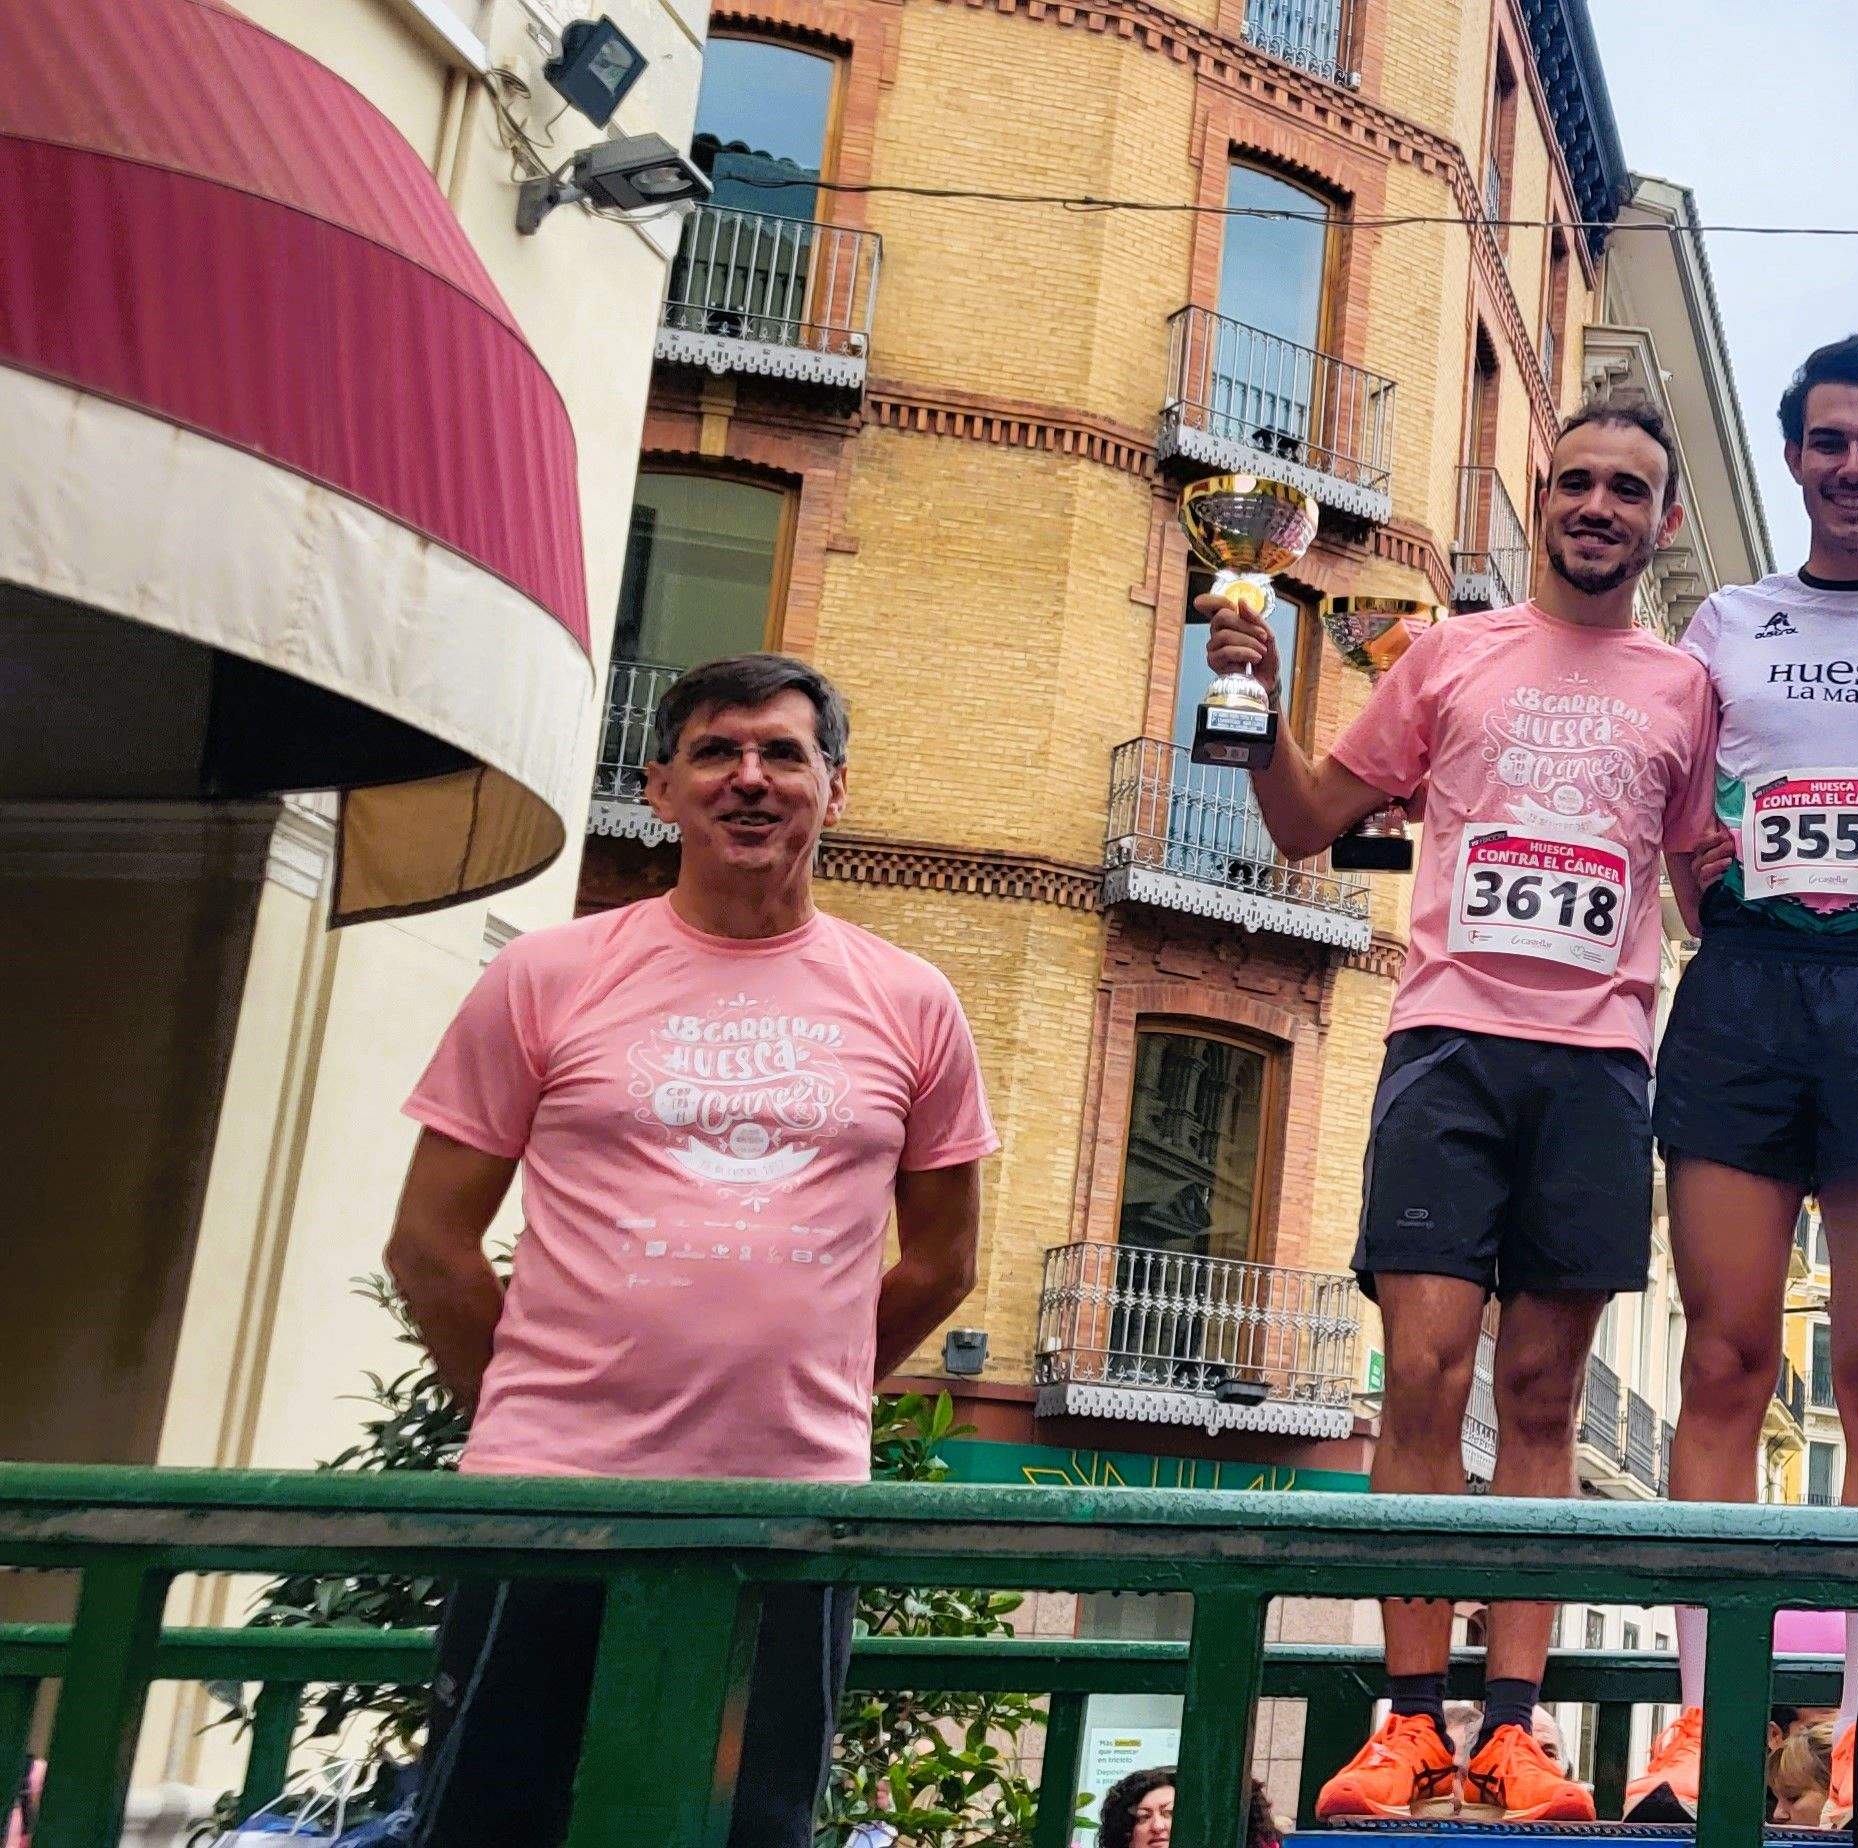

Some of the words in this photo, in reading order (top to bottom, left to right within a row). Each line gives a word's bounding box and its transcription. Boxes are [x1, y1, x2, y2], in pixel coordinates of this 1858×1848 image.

[1810, 782, 1855, 792] HUESCA
[1763, 793, 1822, 808] CONTRA
[1825, 794, 1844, 805] EL
[1530, 842, 1575, 857] HUESCA
[1477, 849, 1540, 868] CONTRA
[1544, 857, 1560, 870] EL
[1564, 858, 1619, 883] CÁNCER
[1467, 870, 1618, 937] 3618
